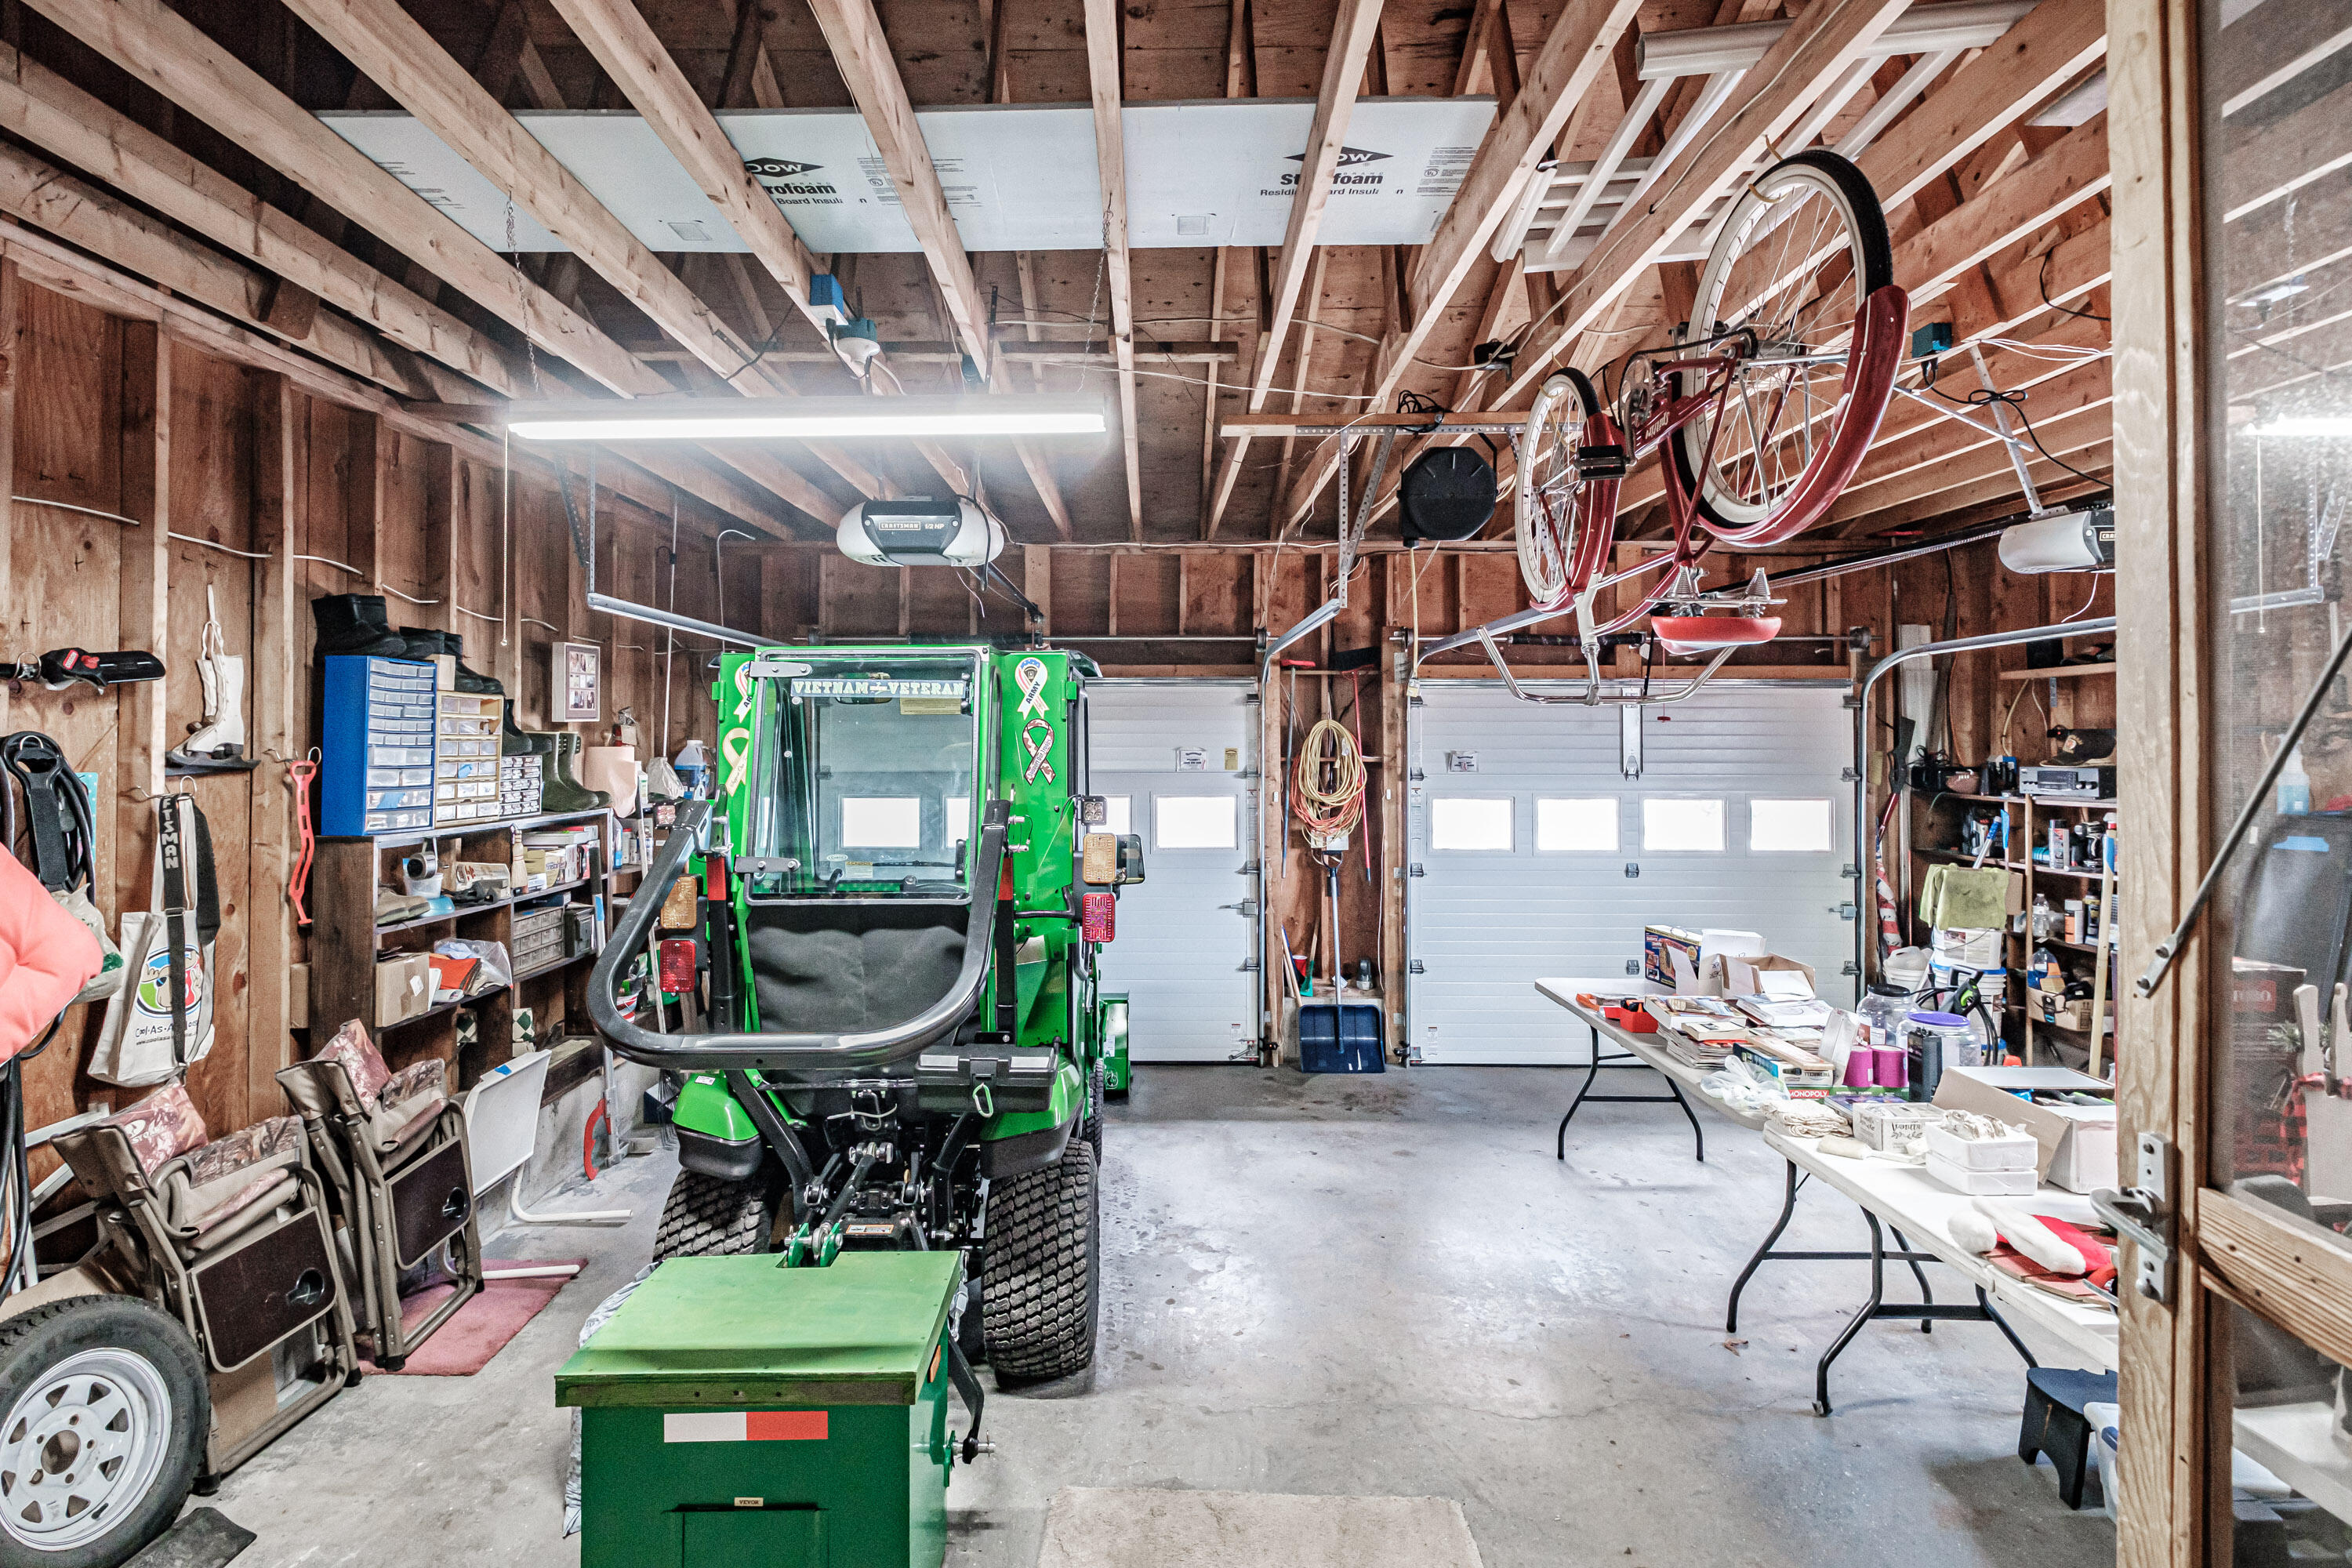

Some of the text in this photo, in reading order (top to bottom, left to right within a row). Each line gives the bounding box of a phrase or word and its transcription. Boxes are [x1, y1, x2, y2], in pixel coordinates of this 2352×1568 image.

[1280, 172, 1383, 185] Stfoam
[764, 183, 837, 195] rofoam
[793, 681, 964, 695] VIETNAM VETERAN
[1025, 681, 1040, 704] ARMY
[743, 696, 752, 707] AR
[162, 798, 179, 869] FTSMAN
